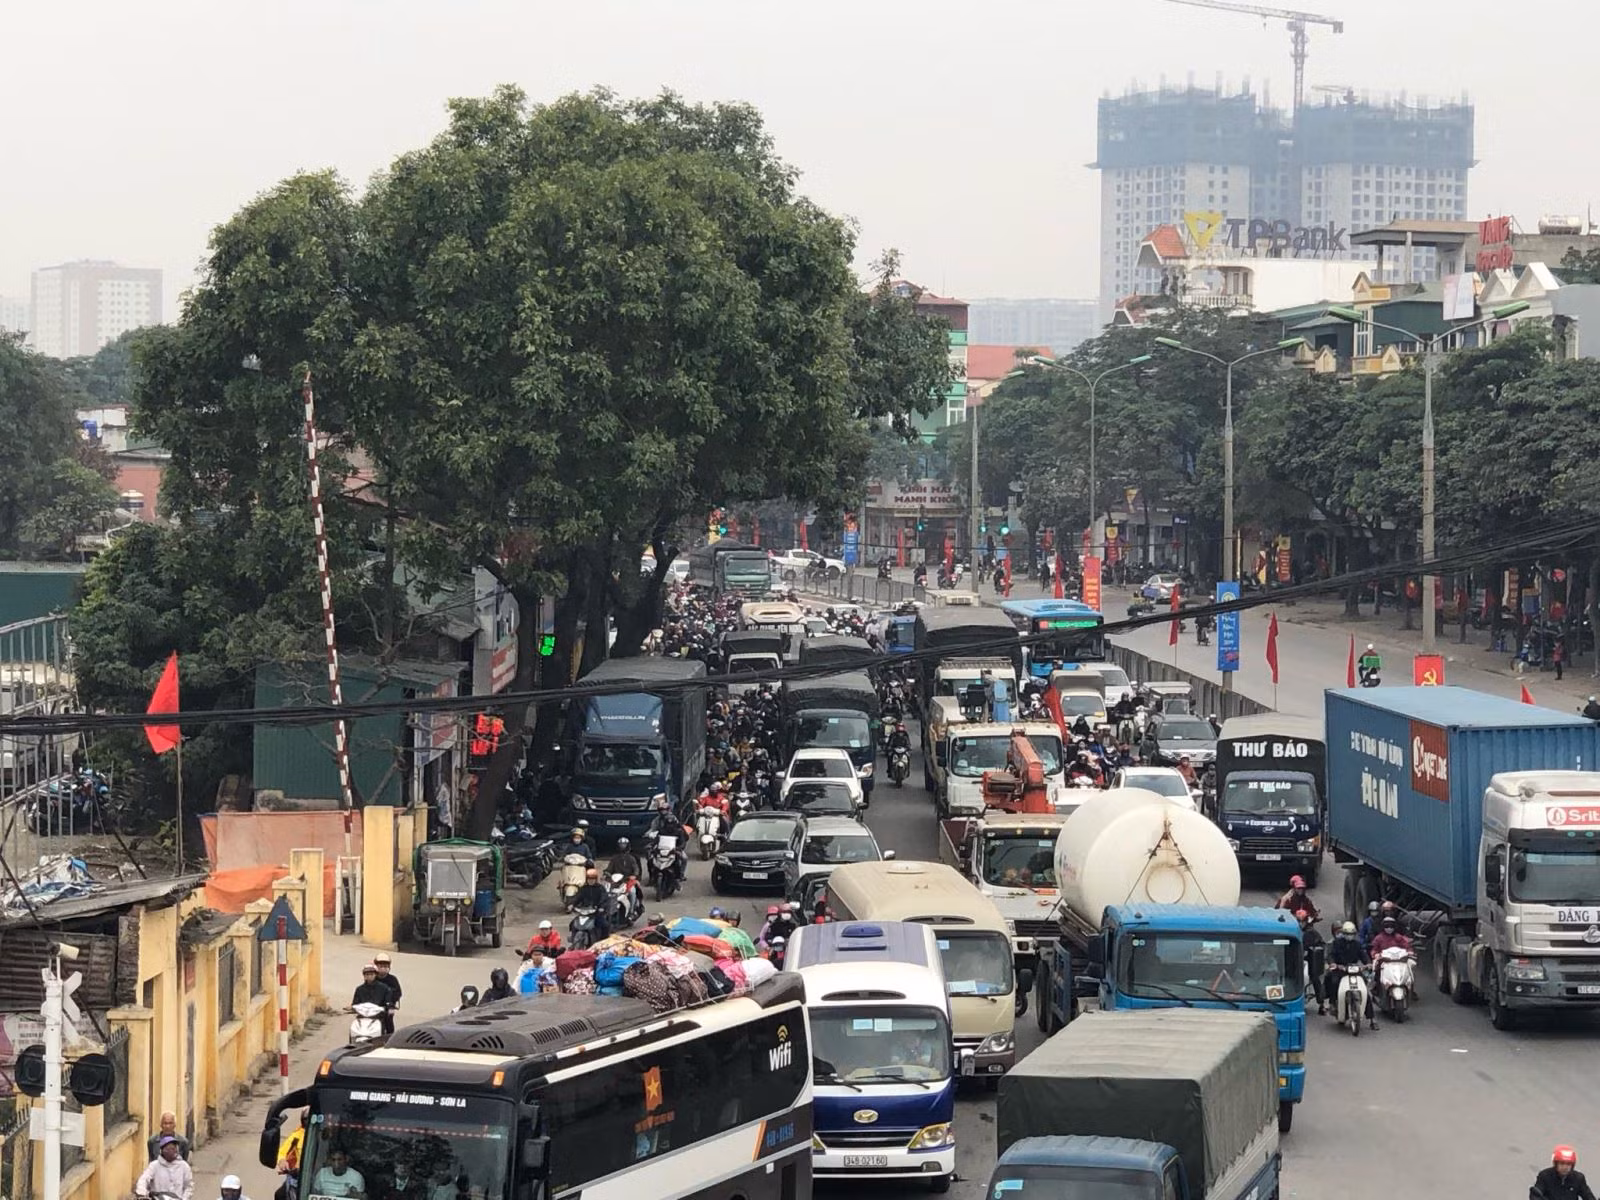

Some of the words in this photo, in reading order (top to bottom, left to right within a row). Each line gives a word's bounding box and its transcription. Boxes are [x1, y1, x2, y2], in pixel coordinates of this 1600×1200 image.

[1226, 218, 1347, 250] TPBank
[1232, 741, 1268, 758] THƯ
[1272, 739, 1308, 758] BÁO
[769, 1041, 792, 1072] Wifi
[456, 1098, 467, 1108] LA
